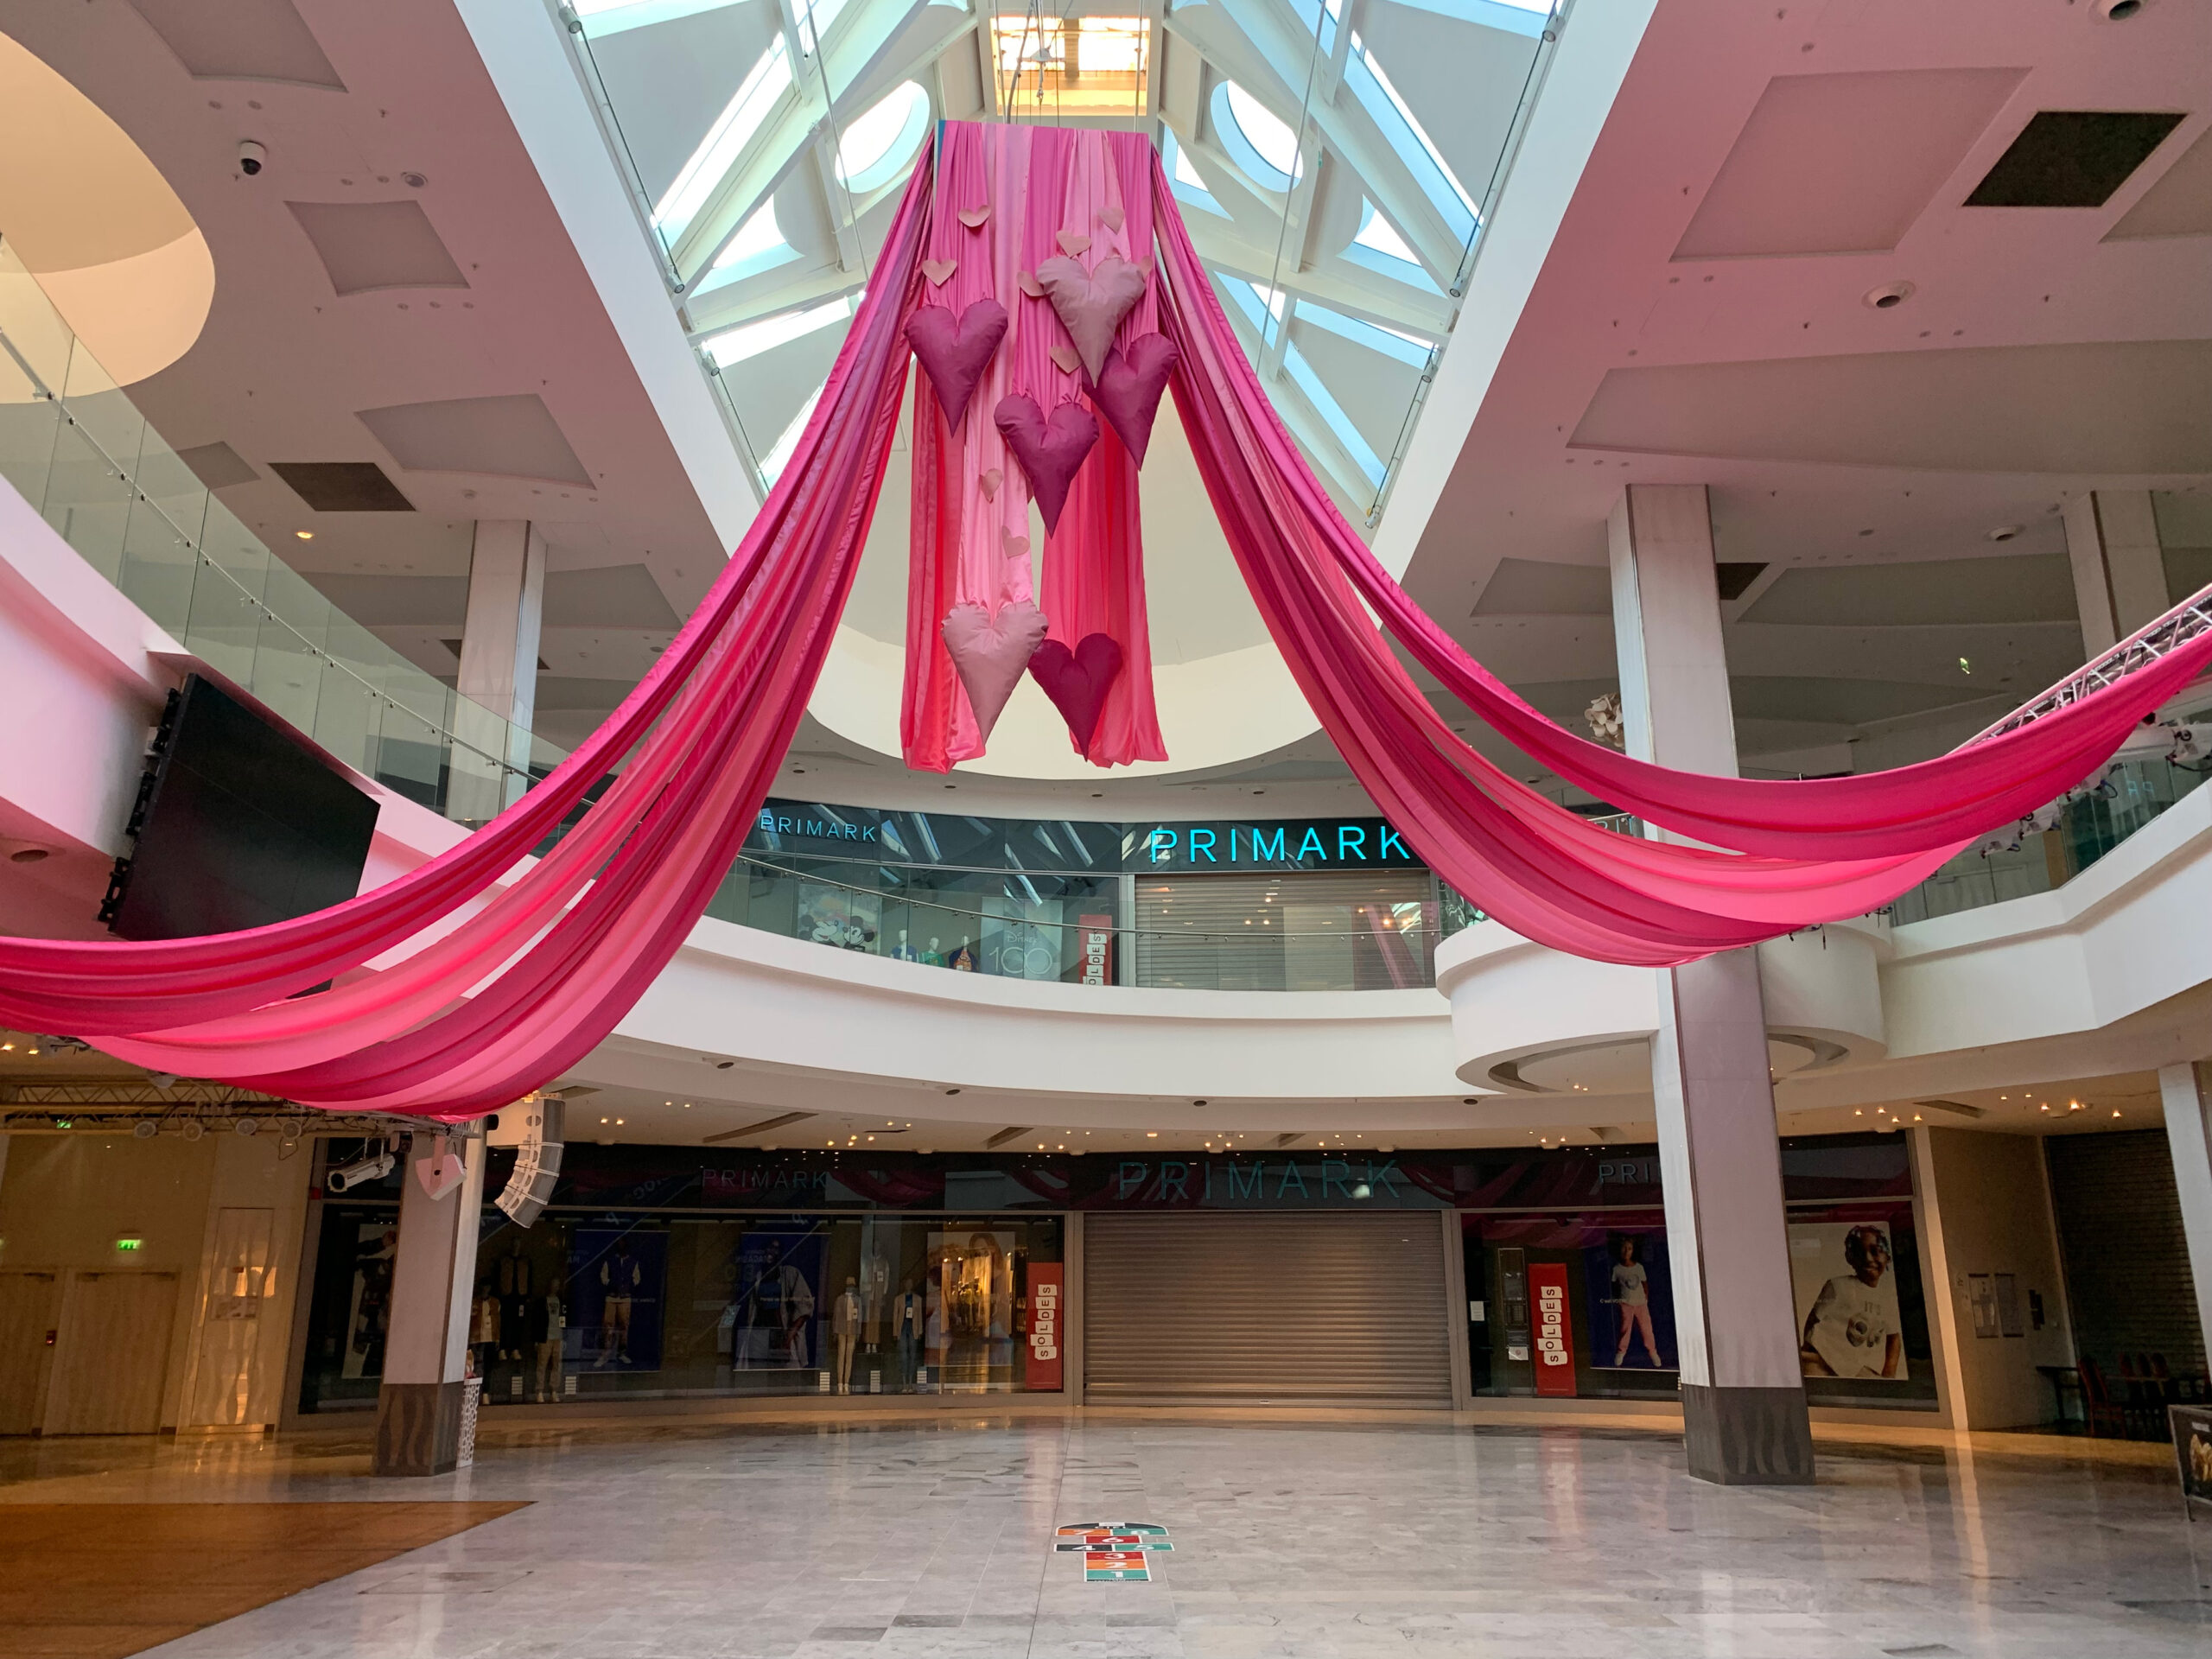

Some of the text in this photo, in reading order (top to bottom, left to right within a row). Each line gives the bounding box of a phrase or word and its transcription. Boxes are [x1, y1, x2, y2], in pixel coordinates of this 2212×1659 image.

[760, 815, 876, 842] PRIMARK
[1151, 826, 1411, 864] PRIMARK
[988, 946, 1053, 975] 100
[702, 1168, 829, 1189] PRIMARK
[1118, 1159, 1400, 1199] PRIMARK
[1598, 1162, 1662, 1185] PRI
[1037, 1286, 1052, 1357] SOLDES
[1545, 1288, 1560, 1363] SOLDES
